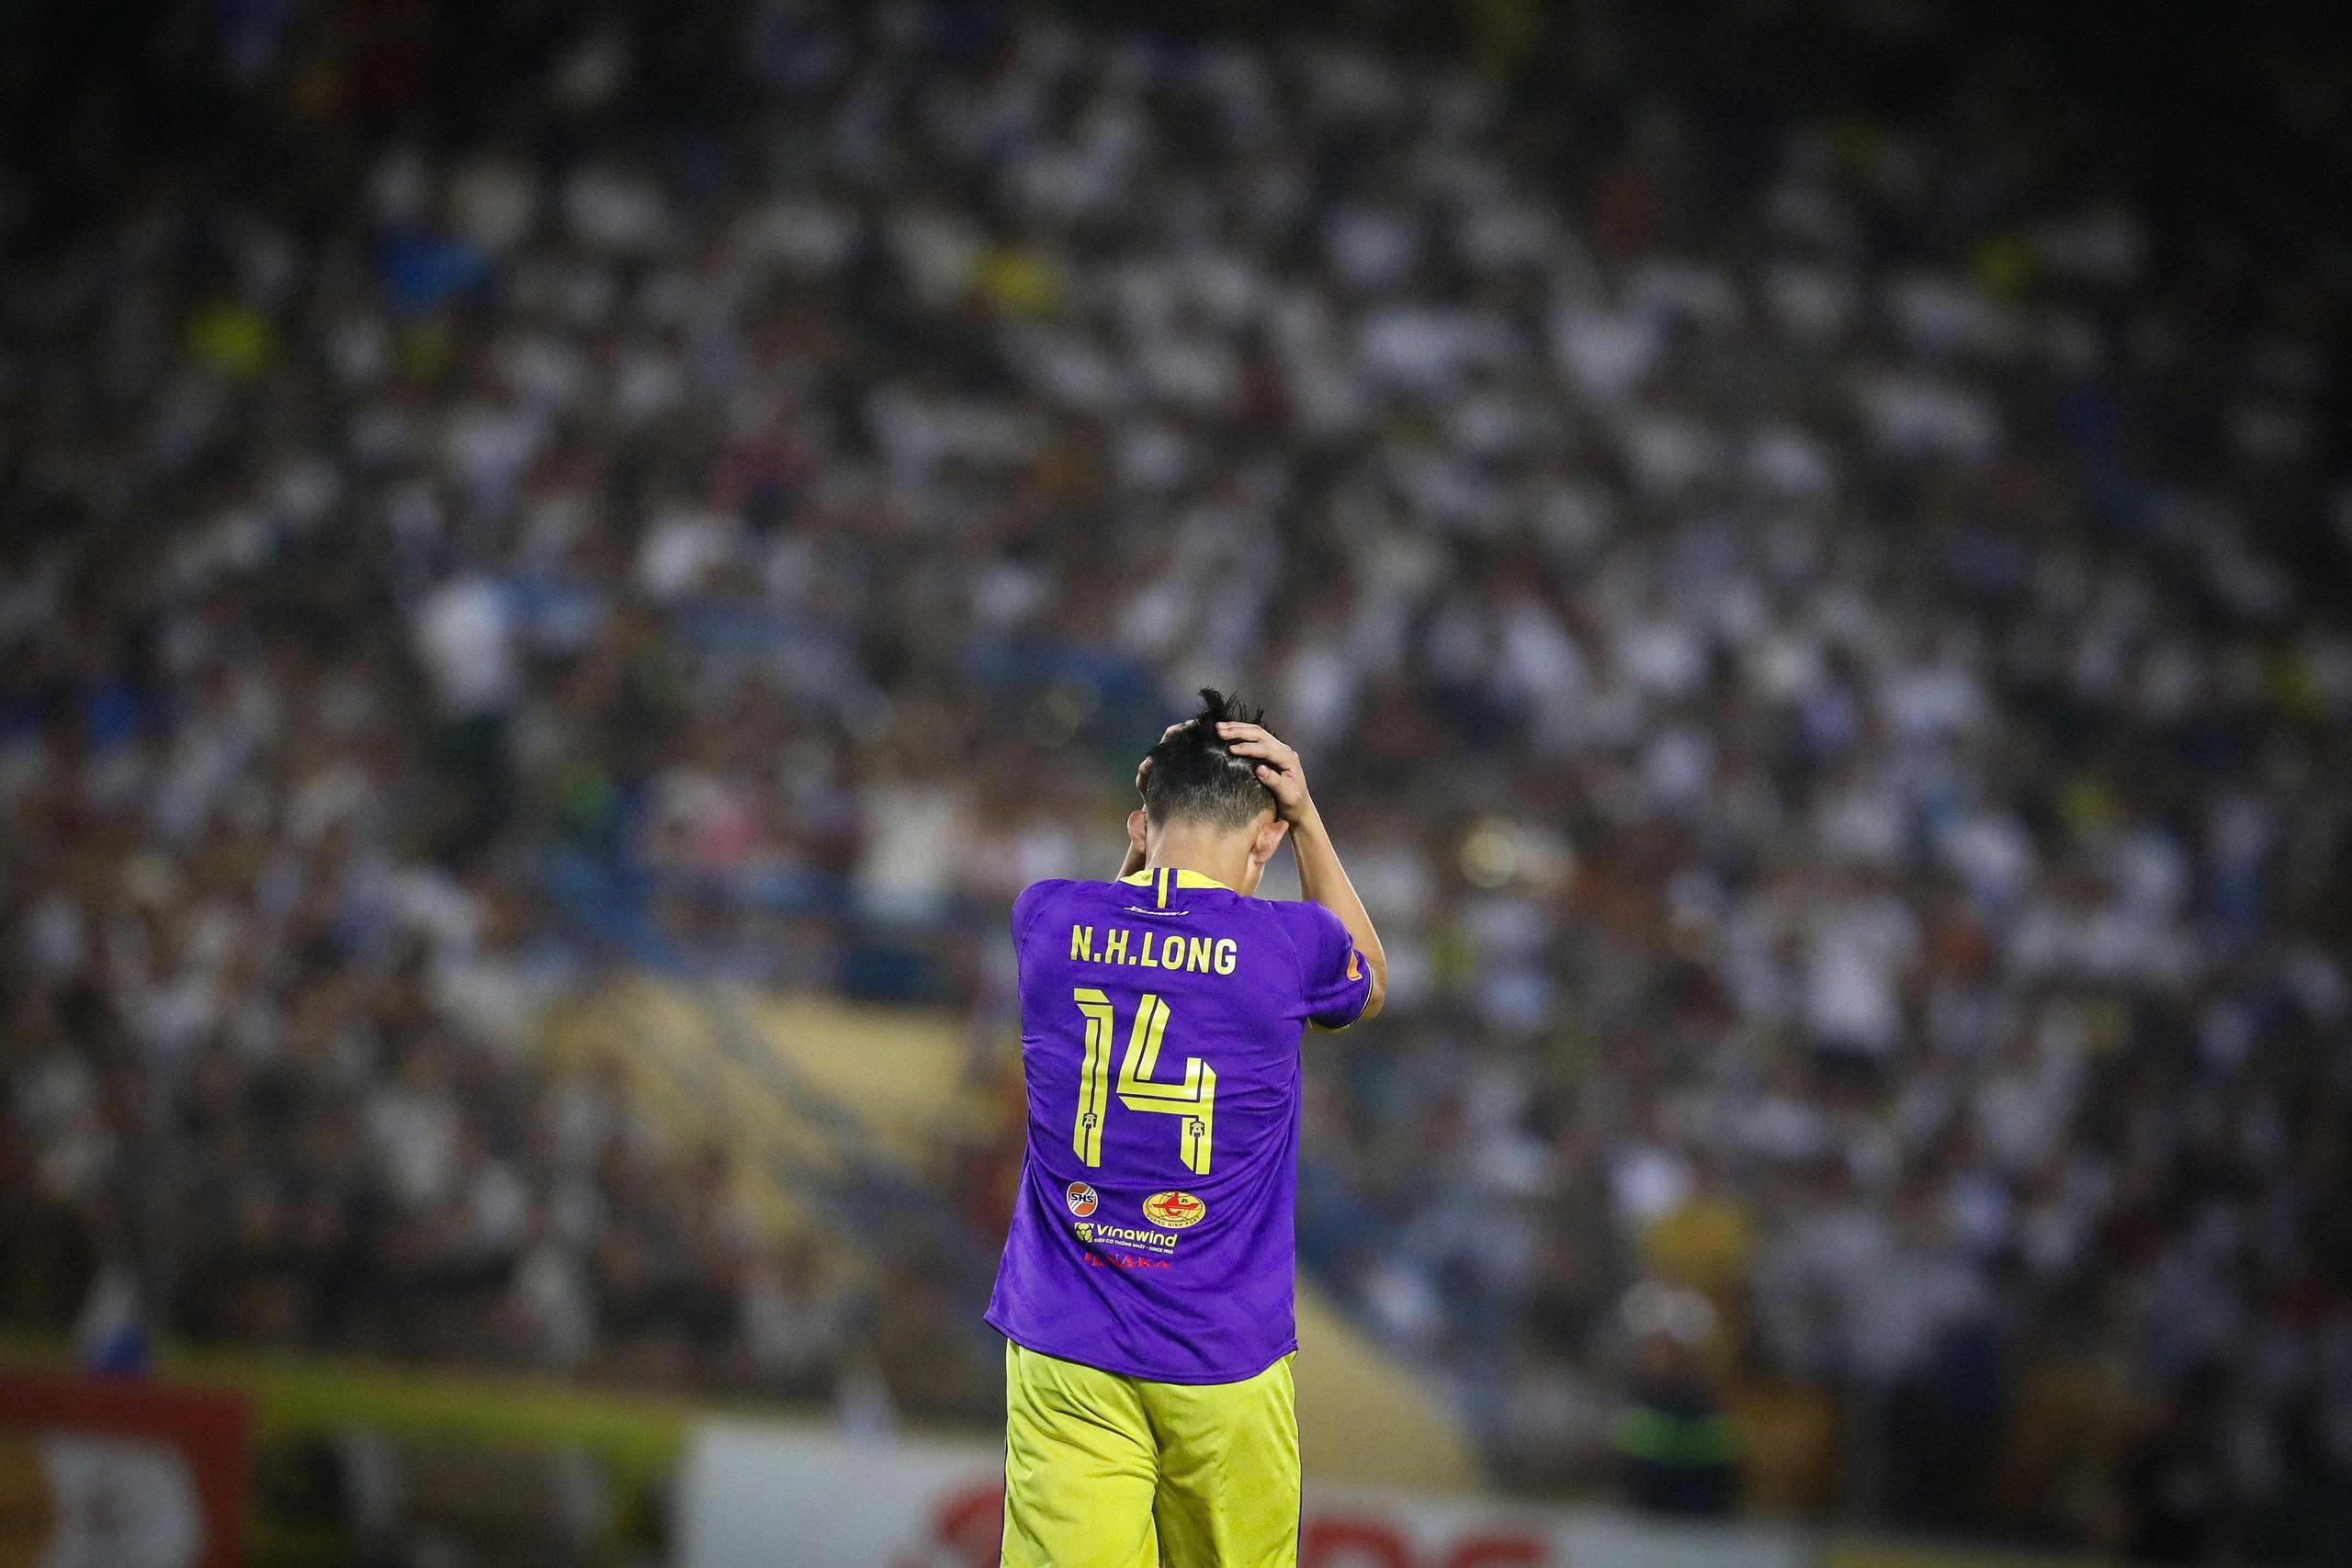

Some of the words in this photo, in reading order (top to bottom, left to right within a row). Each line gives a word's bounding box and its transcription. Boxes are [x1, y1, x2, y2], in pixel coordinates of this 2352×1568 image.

[1070, 924, 1238, 976] N.H.LONG
[1072, 987, 1217, 1175] 14
[1070, 1192, 1094, 1203] SHS
[1096, 1224, 1178, 1247] Vinawind
